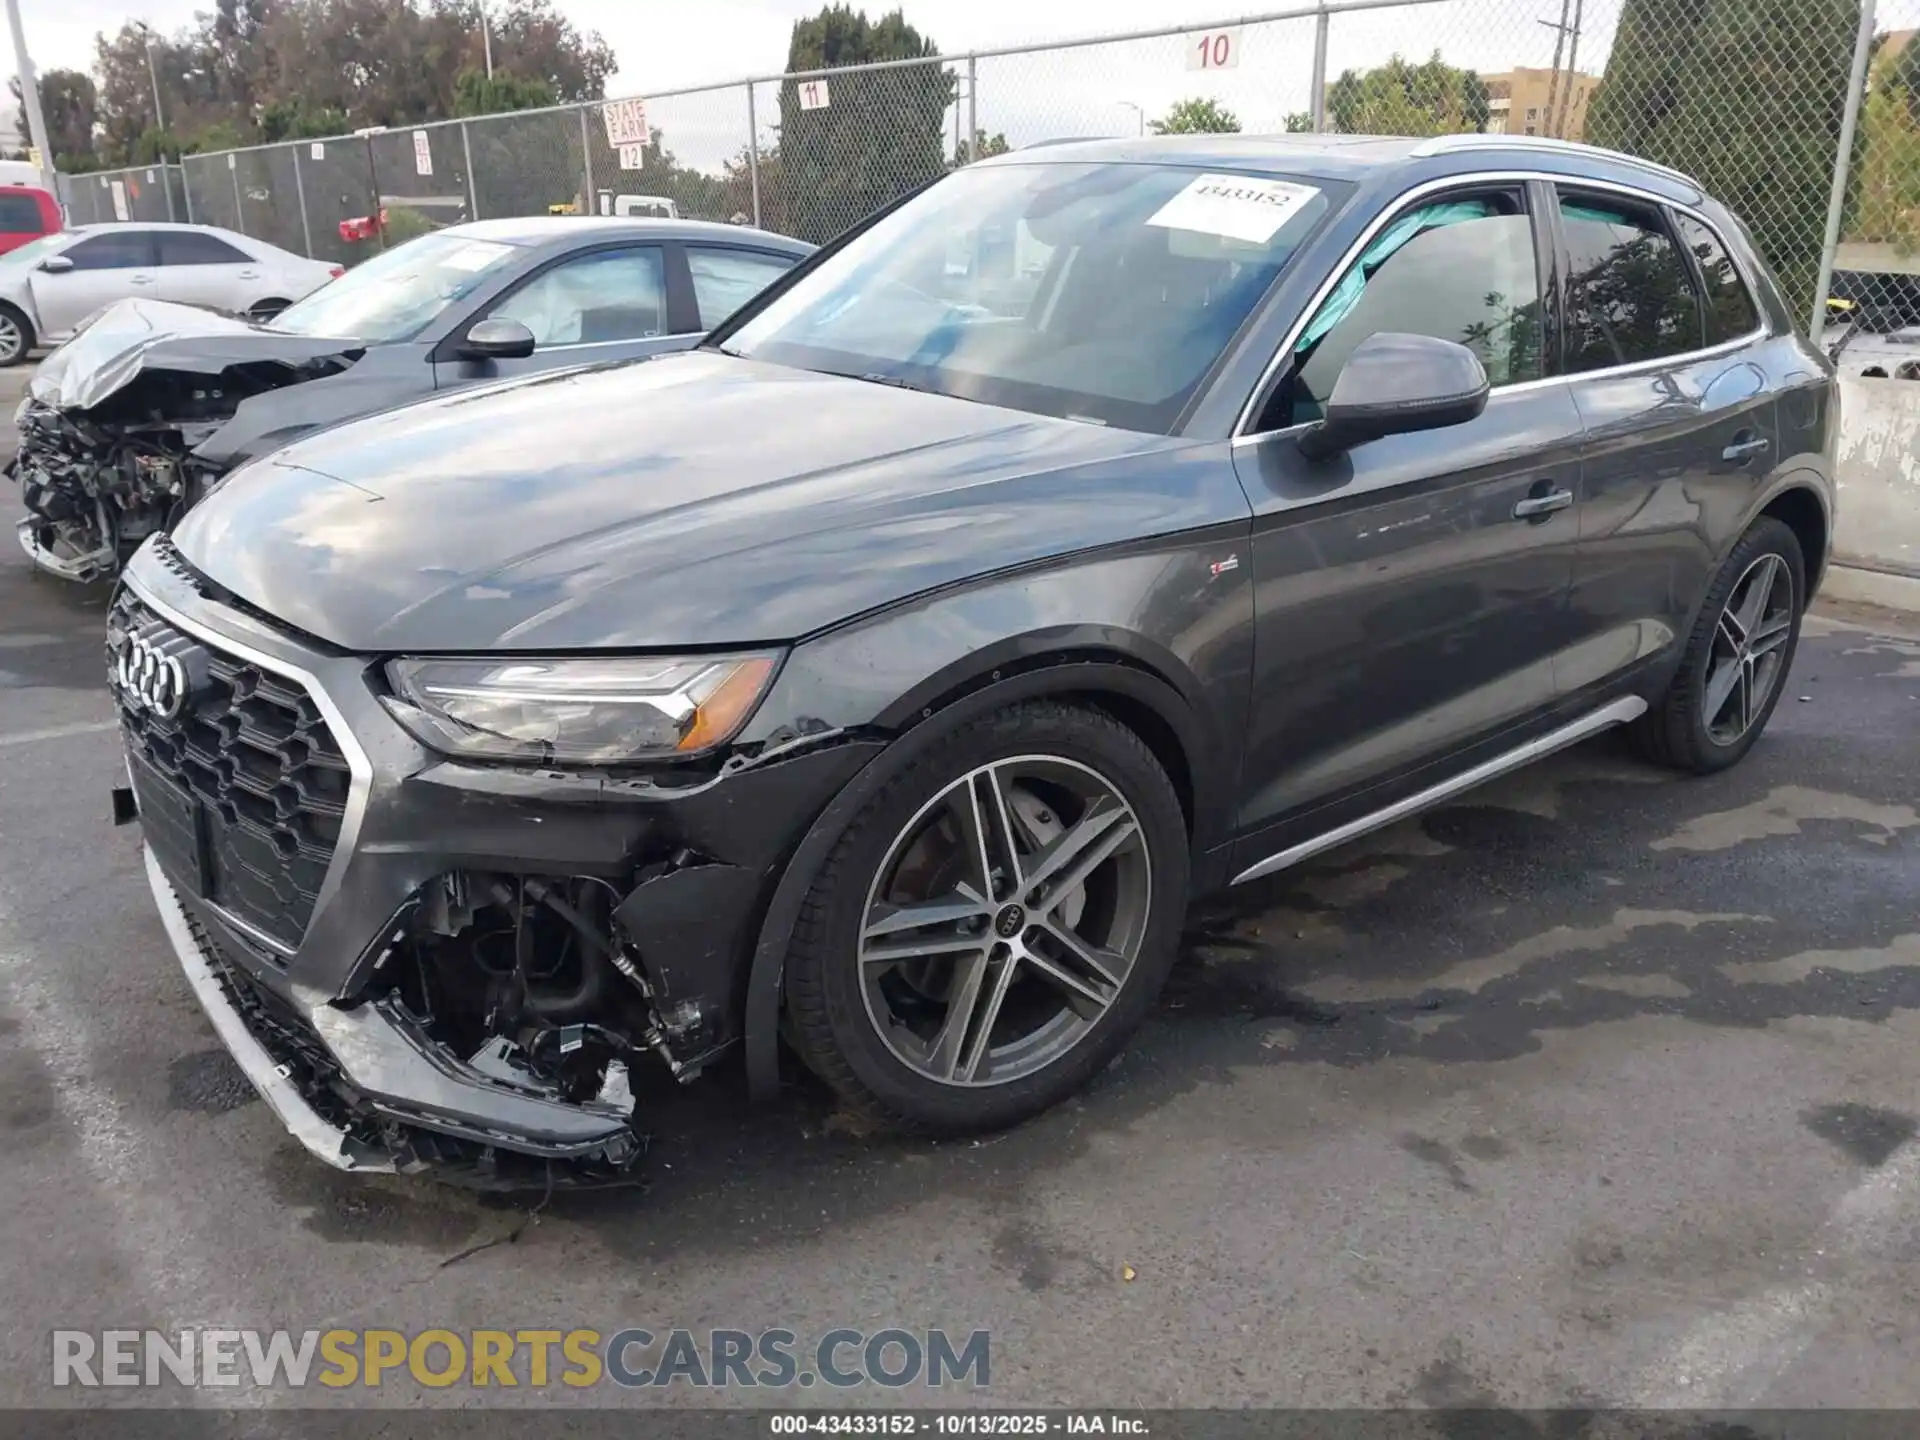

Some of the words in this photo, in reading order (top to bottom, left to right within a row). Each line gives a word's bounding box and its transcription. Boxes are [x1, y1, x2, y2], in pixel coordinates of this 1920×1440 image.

[1197, 34, 1229, 69] 10
[804, 82, 820, 107] 11
[606, 100, 646, 121] STATE
[611, 118, 648, 141] FARM
[623, 146, 639, 167] 12
